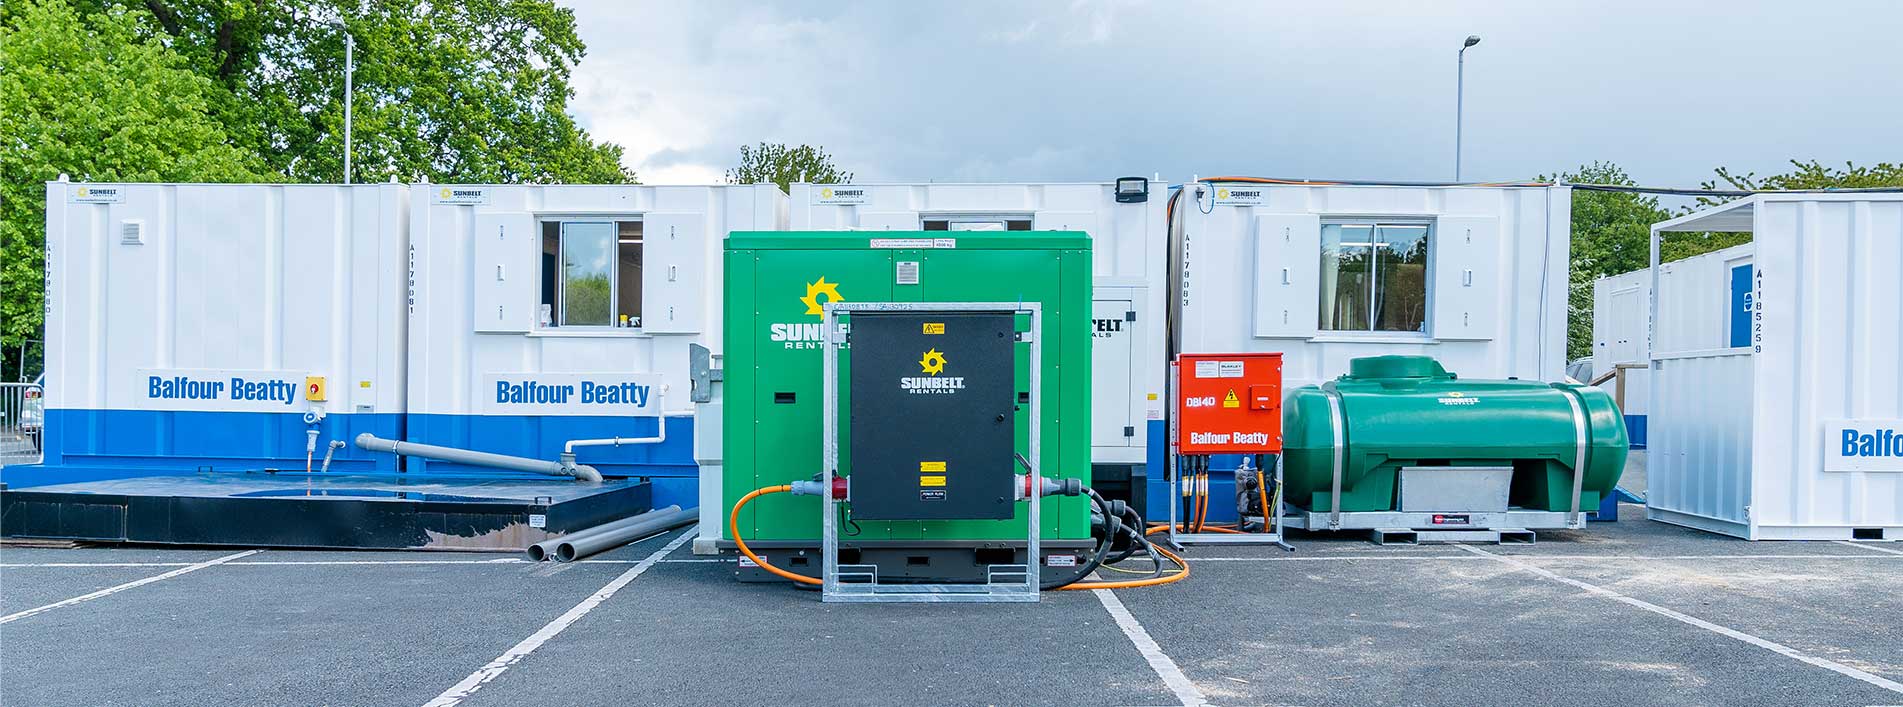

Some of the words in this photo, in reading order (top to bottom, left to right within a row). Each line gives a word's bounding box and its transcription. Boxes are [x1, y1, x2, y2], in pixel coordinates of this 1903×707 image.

[149, 376, 225, 399] Balfour
[231, 377, 297, 405] Beatty
[496, 380, 574, 404] Balfour
[581, 381, 650, 408] Beatty
[1190, 431, 1231, 445] Balfour
[1233, 431, 1269, 446] Beatty
